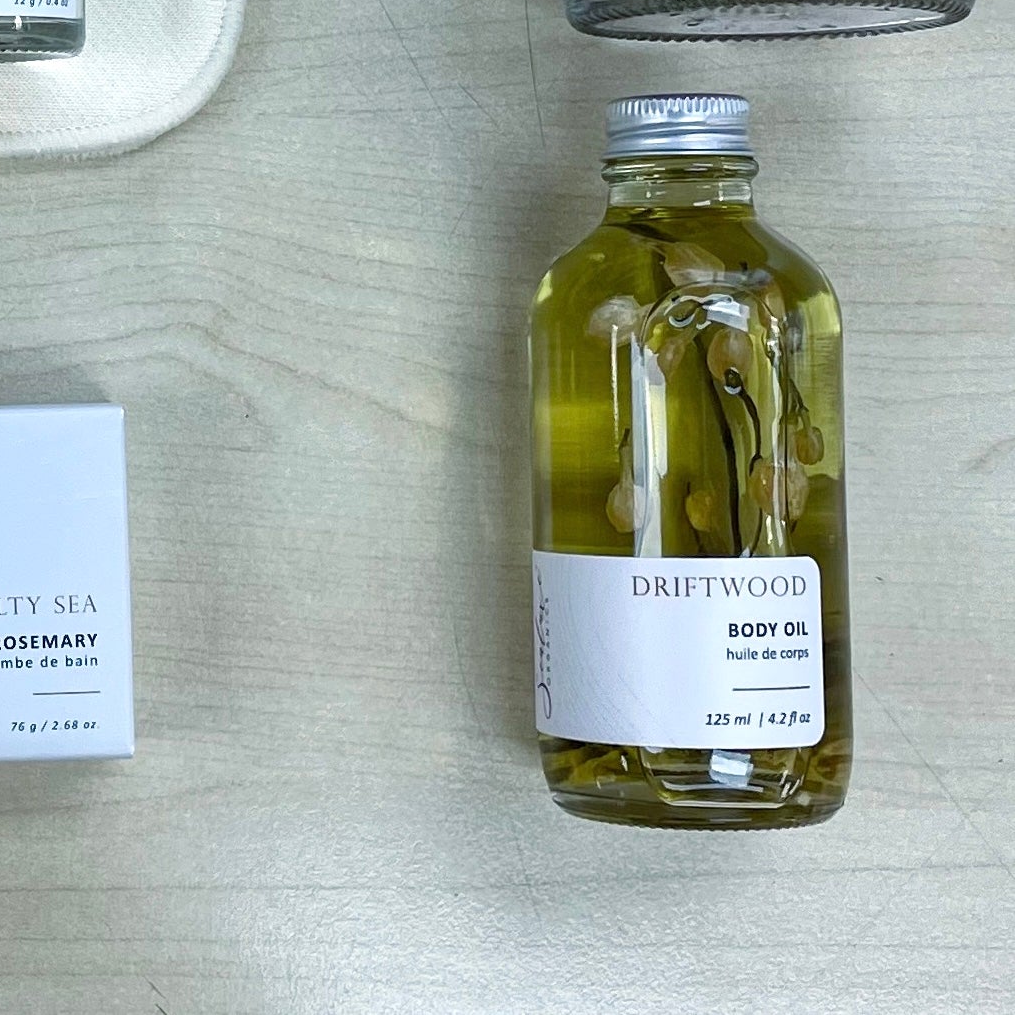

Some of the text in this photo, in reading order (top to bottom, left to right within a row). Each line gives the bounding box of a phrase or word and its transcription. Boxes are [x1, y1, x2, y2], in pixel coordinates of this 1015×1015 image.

[632, 576, 806, 597] DRIFTWOOD
[54, 595, 97, 613] SEA
[729, 621, 808, 637] BODY OIL
[40, 656, 58, 667] de
[66, 655, 98, 666] bain
[727, 647, 809, 660] huile de corps
[12, 722, 25, 731] 76
[30, 724, 36, 733] g
[41, 720, 48, 732] /
[52, 720, 78, 730] 2.68
[706, 714, 730, 725] 125
[734, 713, 751, 725] ml
[768, 713, 786, 724] 4.2
[788, 711, 800, 727] fl
[800, 714, 810, 723] oz
